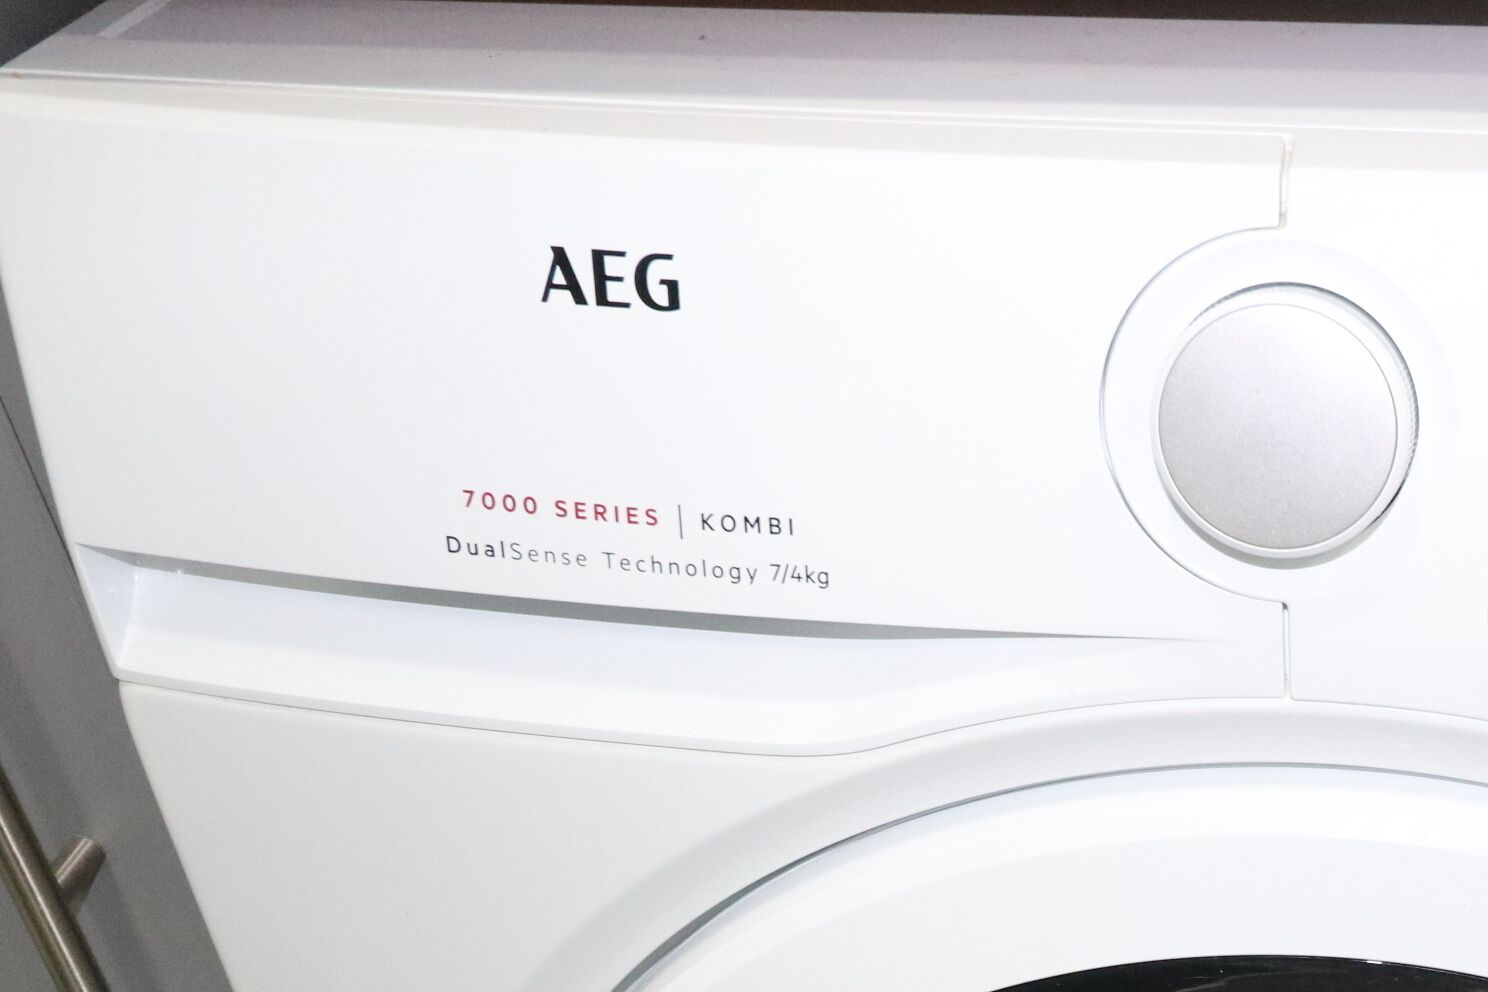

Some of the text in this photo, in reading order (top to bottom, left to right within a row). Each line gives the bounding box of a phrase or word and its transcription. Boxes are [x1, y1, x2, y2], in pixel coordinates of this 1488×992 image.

[541, 245, 681, 312] AEG
[461, 488, 660, 527] 7000 SERIES
[700, 512, 796, 537] KOMBI
[445, 534, 831, 590] DualSense Technology 7/4kg
